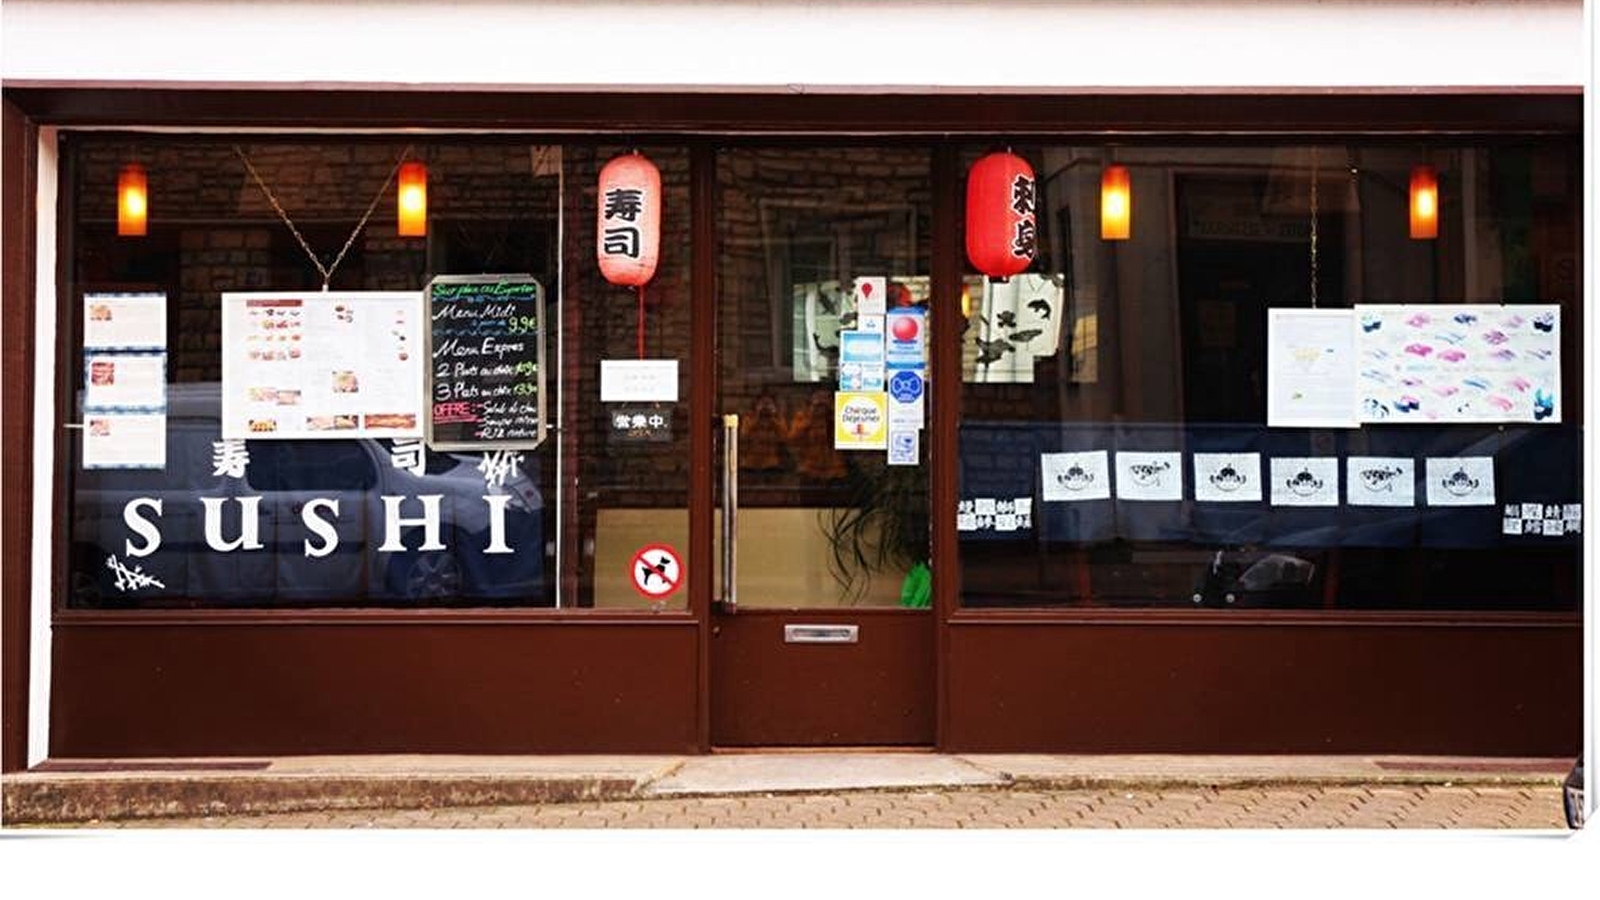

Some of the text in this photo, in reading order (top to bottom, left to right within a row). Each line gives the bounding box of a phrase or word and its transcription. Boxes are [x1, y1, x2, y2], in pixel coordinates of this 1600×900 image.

[603, 187, 642, 259] 寿司
[432, 303, 517, 321] Menu Midi
[432, 337, 480, 359] Menu
[435, 362, 451, 377] 2
[454, 361, 479, 376] Plats
[434, 382, 451, 401] 3
[453, 381, 480, 399] Plats
[122, 493, 514, 557] SUSHI
